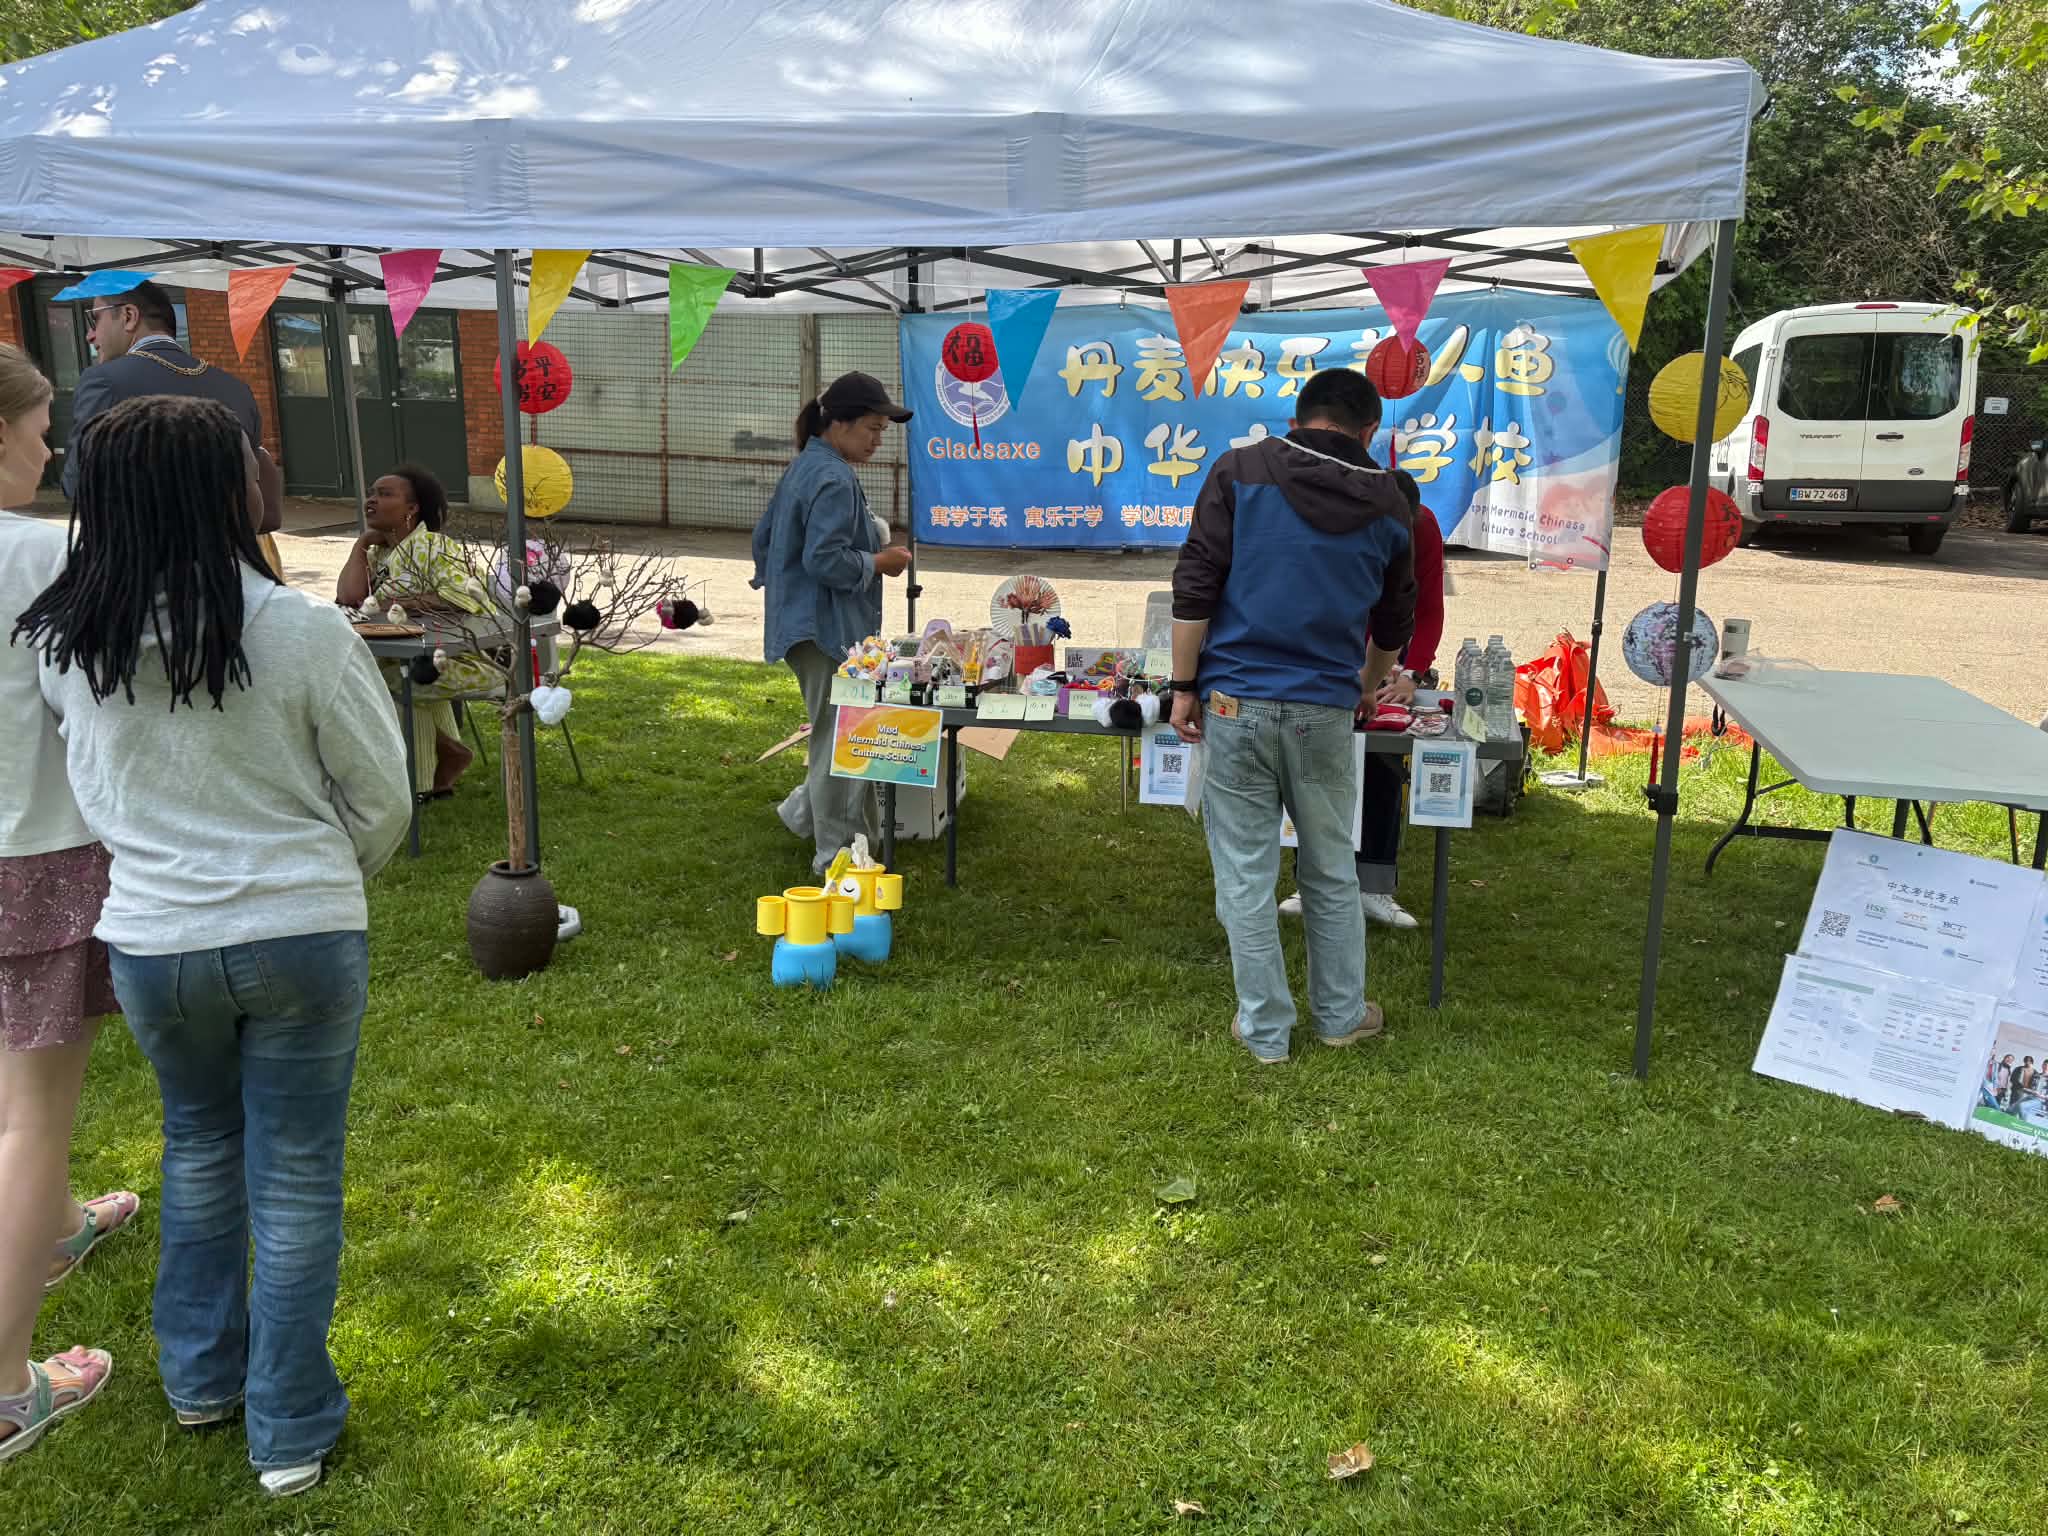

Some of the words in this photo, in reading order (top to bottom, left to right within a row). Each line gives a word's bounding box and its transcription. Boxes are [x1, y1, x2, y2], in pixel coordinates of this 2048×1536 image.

[947, 332, 984, 367] 福
[928, 437, 1041, 460] Gladsaxe
[1813, 489, 1825, 499] 72
[1827, 489, 1846, 499] 468
[1538, 514, 1585, 532] Chinese
[847, 733, 888, 748] Mermaid
